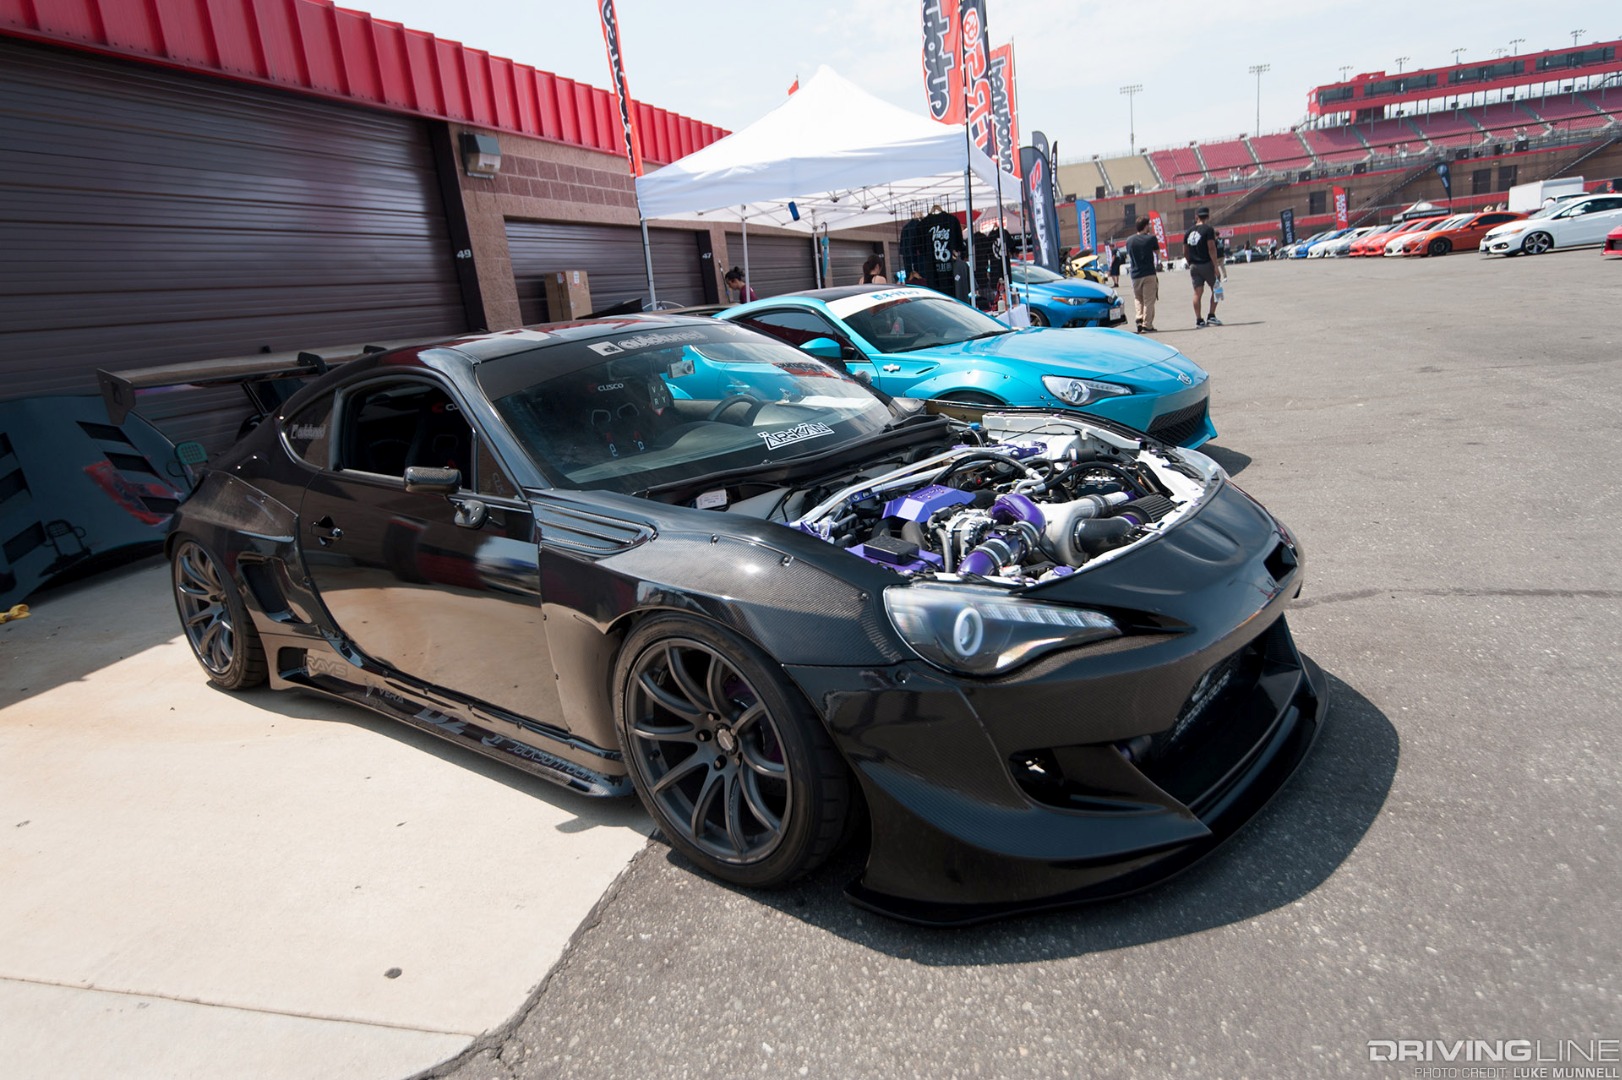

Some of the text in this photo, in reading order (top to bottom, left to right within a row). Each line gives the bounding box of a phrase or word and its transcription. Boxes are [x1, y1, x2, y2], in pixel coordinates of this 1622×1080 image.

[456, 248, 472, 260] 49
[934, 240, 952, 263] 86
[597, 382, 625, 392] CUSCO
[303, 653, 349, 678] RAYS
[413, 703, 470, 735] D2
